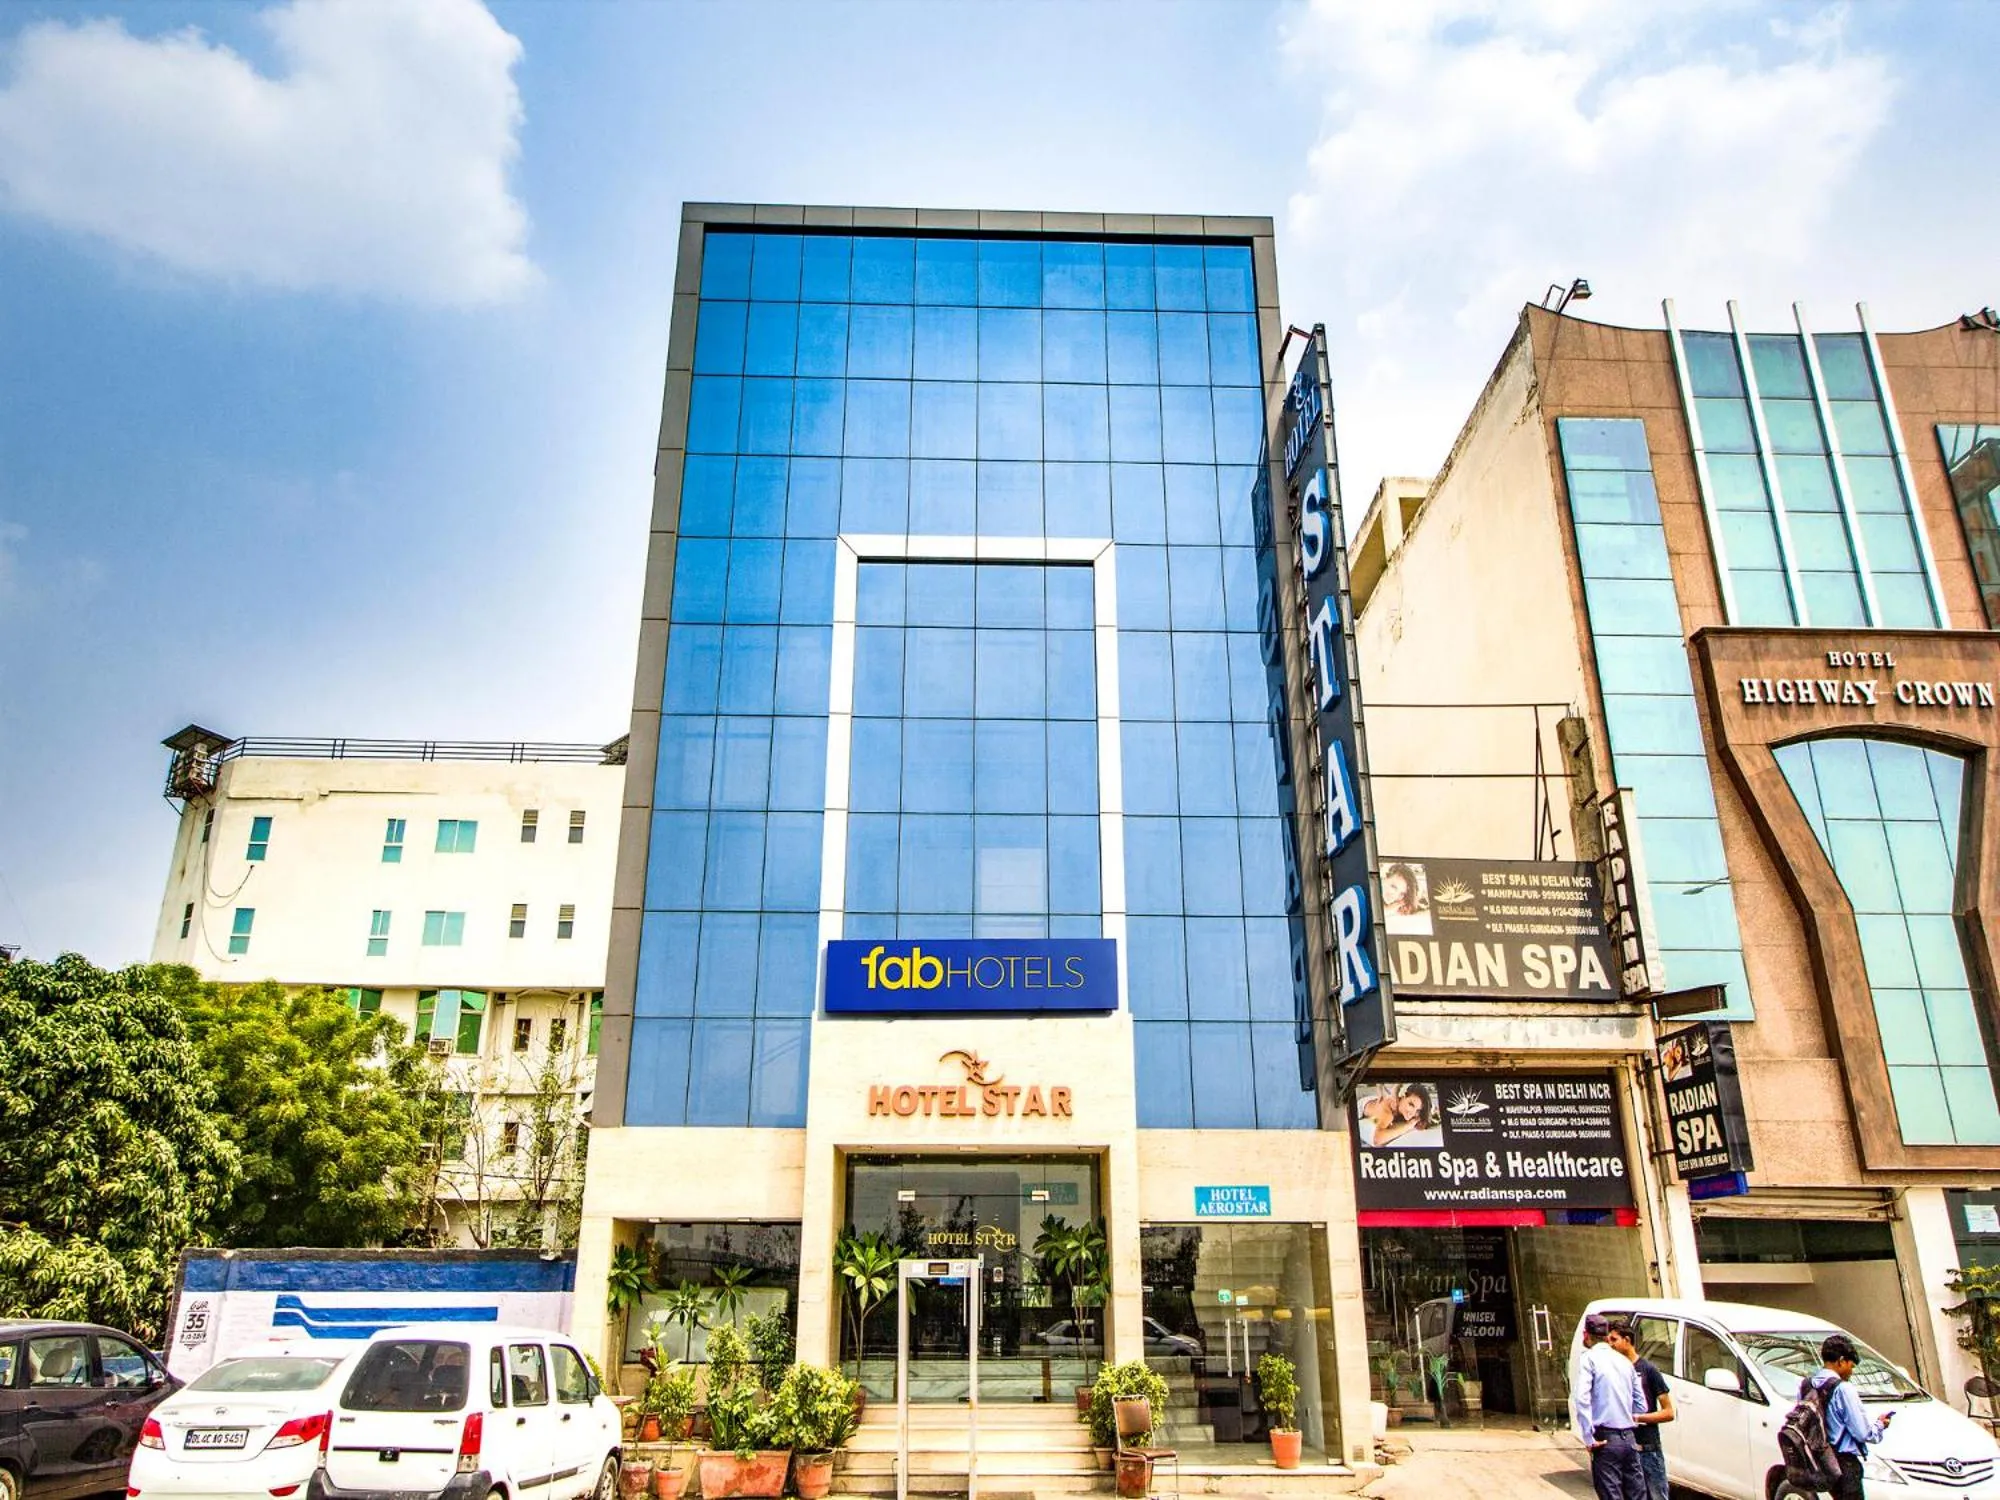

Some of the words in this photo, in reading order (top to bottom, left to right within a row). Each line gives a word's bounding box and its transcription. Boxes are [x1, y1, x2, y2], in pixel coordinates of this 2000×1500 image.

[1828, 651, 1896, 668] HOTEL
[1740, 678, 1878, 705] HIGHWAY
[1895, 680, 1995, 707] CROWN
[1301, 468, 1378, 1007] STAR
[1482, 873, 1506, 886] BEST
[1509, 874, 1527, 887] SPA
[1530, 874, 1540, 887] IN
[1542, 875, 1570, 888] DELHI
[1572, 876, 1593, 888] NCR
[1521, 943, 1611, 990] SPA
[1494, 1083, 1521, 1099] BEST
[1523, 1083, 1542, 1099] SPA
[1544, 1083, 1555, 1099] IN
[1557, 1083, 1587, 1099] DELHI
[1589, 1083, 1611, 1099] NCR
[1669, 1081, 1718, 1116] RADIAN
[868, 1085, 976, 1117] HOTEL
[982, 1085, 1073, 1117] STAR
[1520, 1118, 1536, 1126] ROAD
[1676, 1114, 1723, 1156] SPA
[1360, 1152, 1432, 1179] Radian
[1438, 1151, 1478, 1185] Spa
[1485, 1151, 1502, 1178] &
[1506, 1151, 1624, 1178] Healthcare
[1678, 1159, 1689, 1171] BEST
[1689, 1158, 1698, 1169] SPA
[1718, 1152, 1729, 1165] NCR
[1210, 1188, 1257, 1202] HOTEL
[1424, 1187, 1567, 1202] www.radianspa.com
[928, 1232, 973, 1245] HOTEL
[975, 1228, 1017, 1246] STAR
[1468, 1267, 1507, 1303] Spa
[186, 1313, 206, 1330] 35
[224, 1433, 244, 1444] 5451
